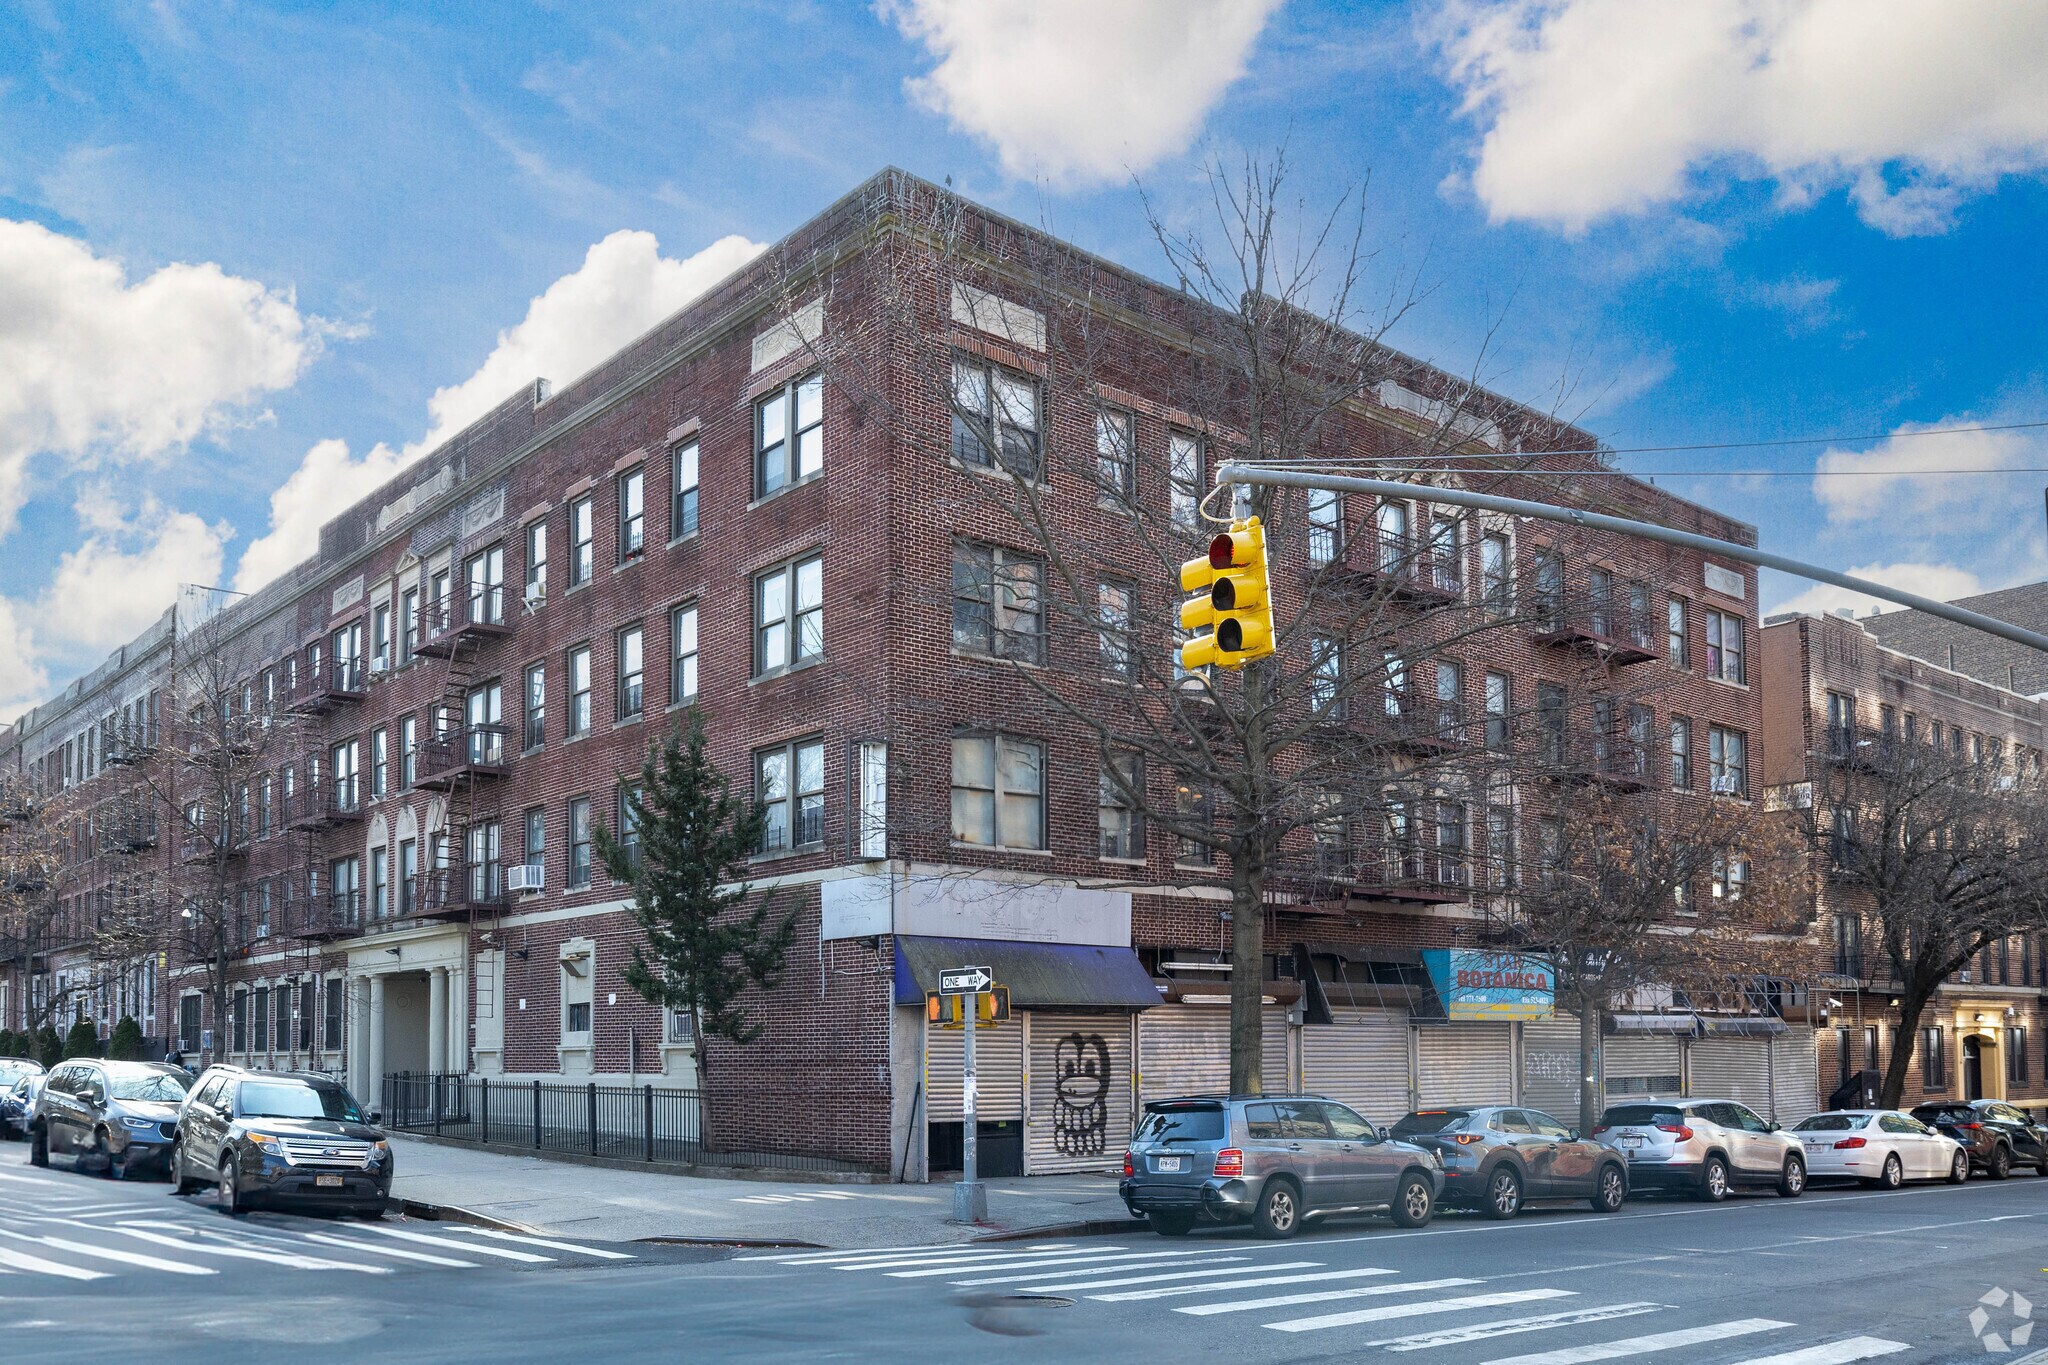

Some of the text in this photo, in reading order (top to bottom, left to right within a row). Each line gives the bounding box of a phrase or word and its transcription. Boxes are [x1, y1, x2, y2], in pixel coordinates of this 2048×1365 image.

[1484, 953, 1523, 970] STAR
[944, 975, 983, 987] ONE WAY
[1457, 970, 1548, 989] BOTANICA
